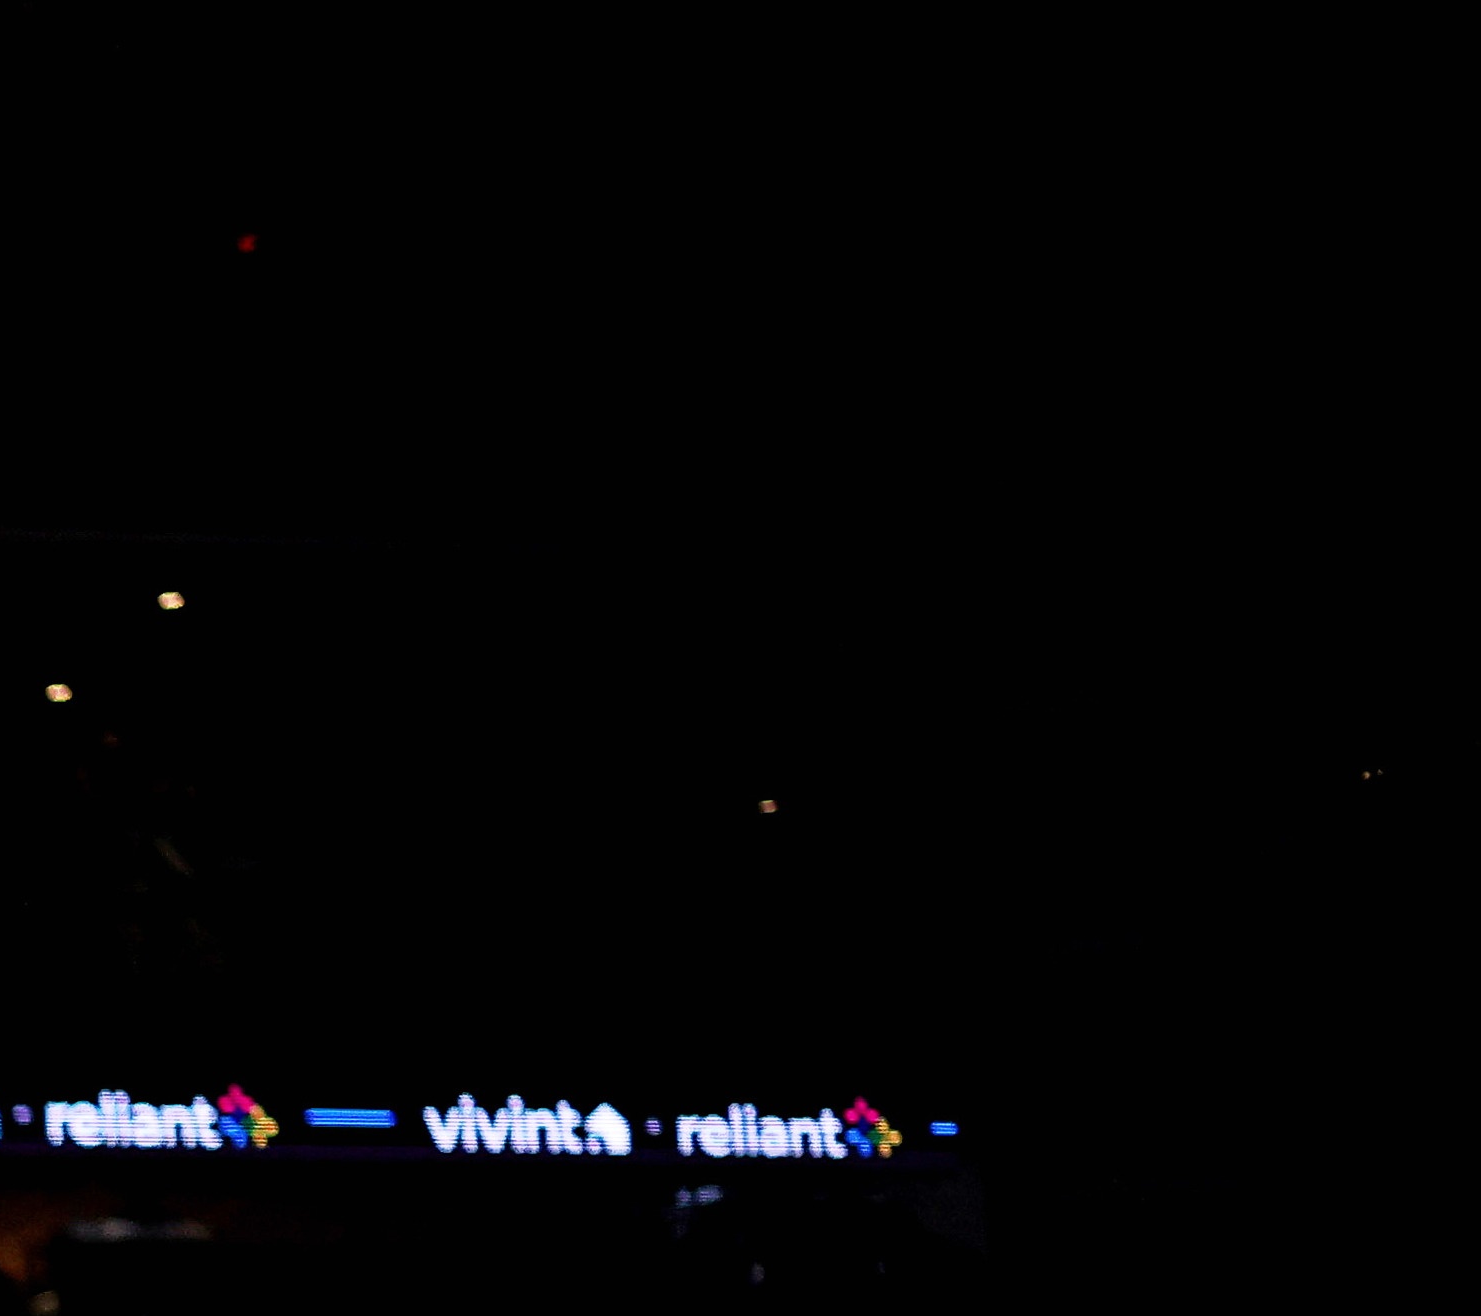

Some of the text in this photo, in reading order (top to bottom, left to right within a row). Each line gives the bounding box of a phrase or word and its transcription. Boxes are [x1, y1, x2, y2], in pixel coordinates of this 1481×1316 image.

[45, 1091, 223, 1149] reliant
[423, 1094, 579, 1155] vivint
[676, 1102, 848, 1159] reliant
